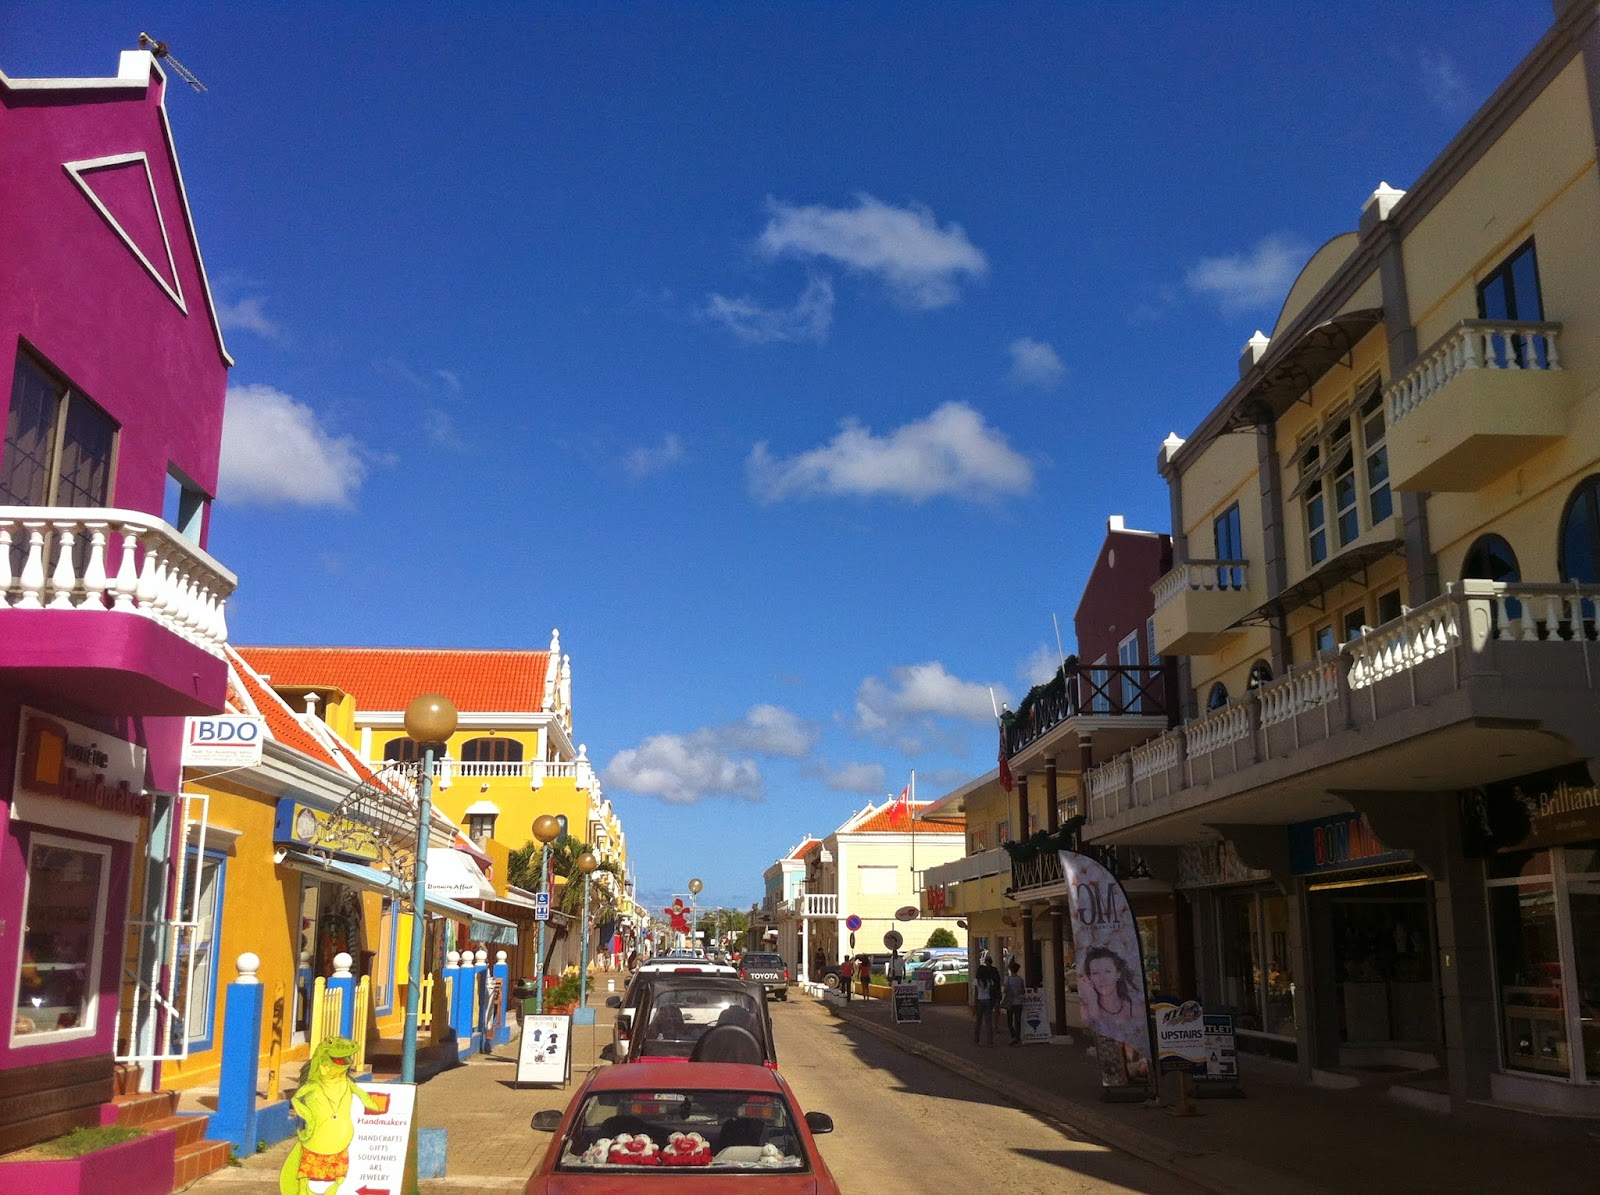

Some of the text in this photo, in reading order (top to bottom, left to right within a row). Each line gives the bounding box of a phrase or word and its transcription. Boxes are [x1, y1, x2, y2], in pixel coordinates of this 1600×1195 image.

[199, 721, 258, 741] BDO
[750, 972, 779, 980] TOYOTA
[1161, 1030, 1203, 1040] UPSTAIRS
[357, 1118, 407, 1126] Handmakers
[358, 1154, 397, 1162] SOUVENIRS
